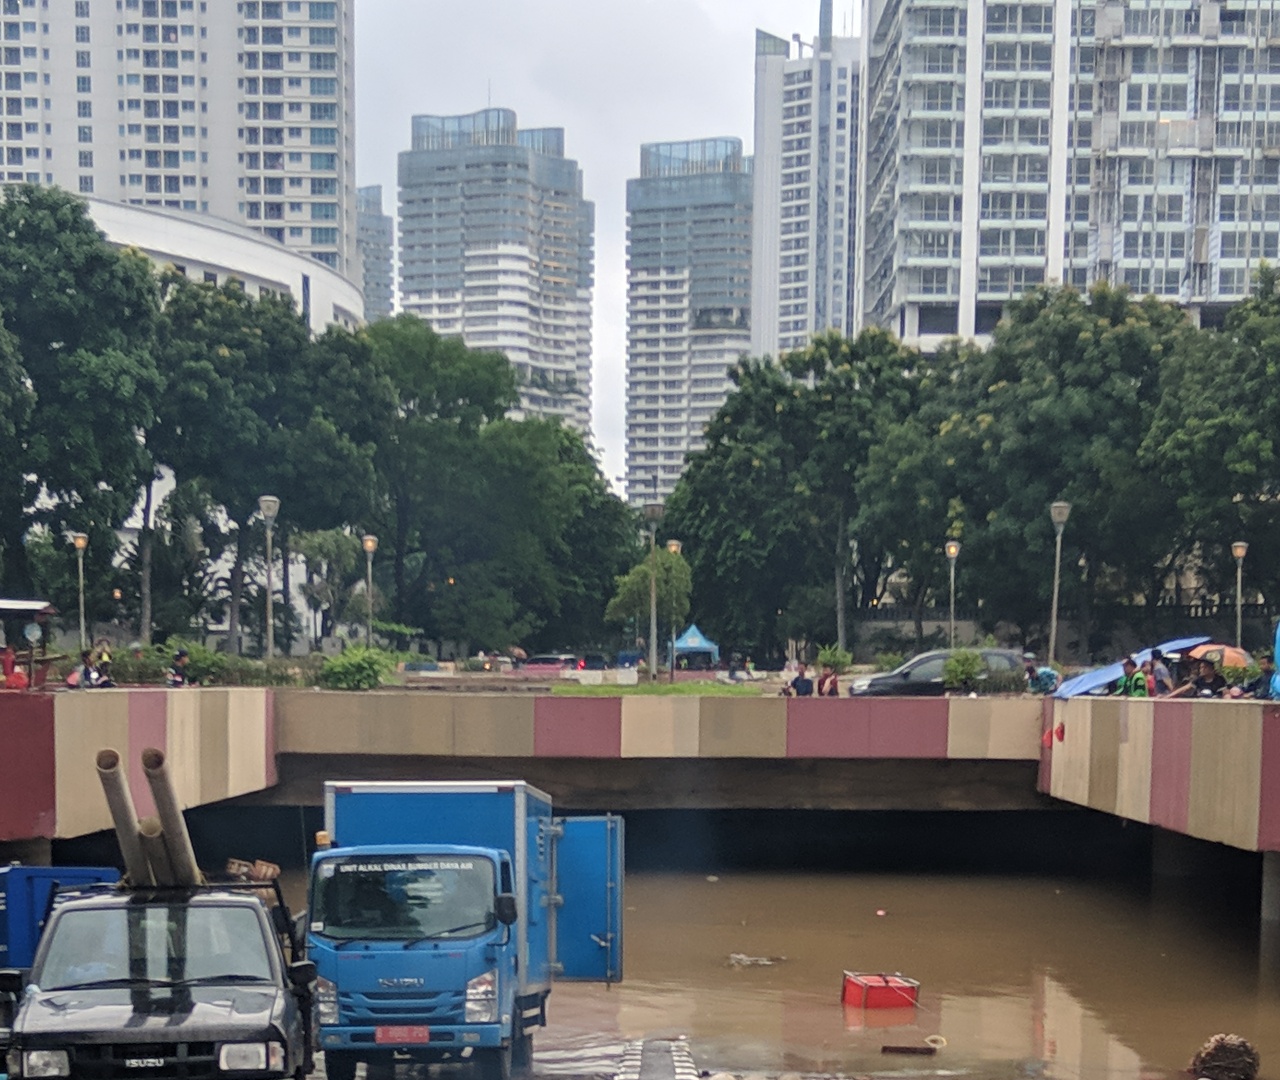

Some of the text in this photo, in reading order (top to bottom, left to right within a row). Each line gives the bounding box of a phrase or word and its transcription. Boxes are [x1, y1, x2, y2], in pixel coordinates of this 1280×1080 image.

[340, 863, 357, 872] UNIT
[439, 861, 459, 870] DAYA
[460, 861, 474, 870] AIR
[125, 1058, 165, 1068] ISUZU
